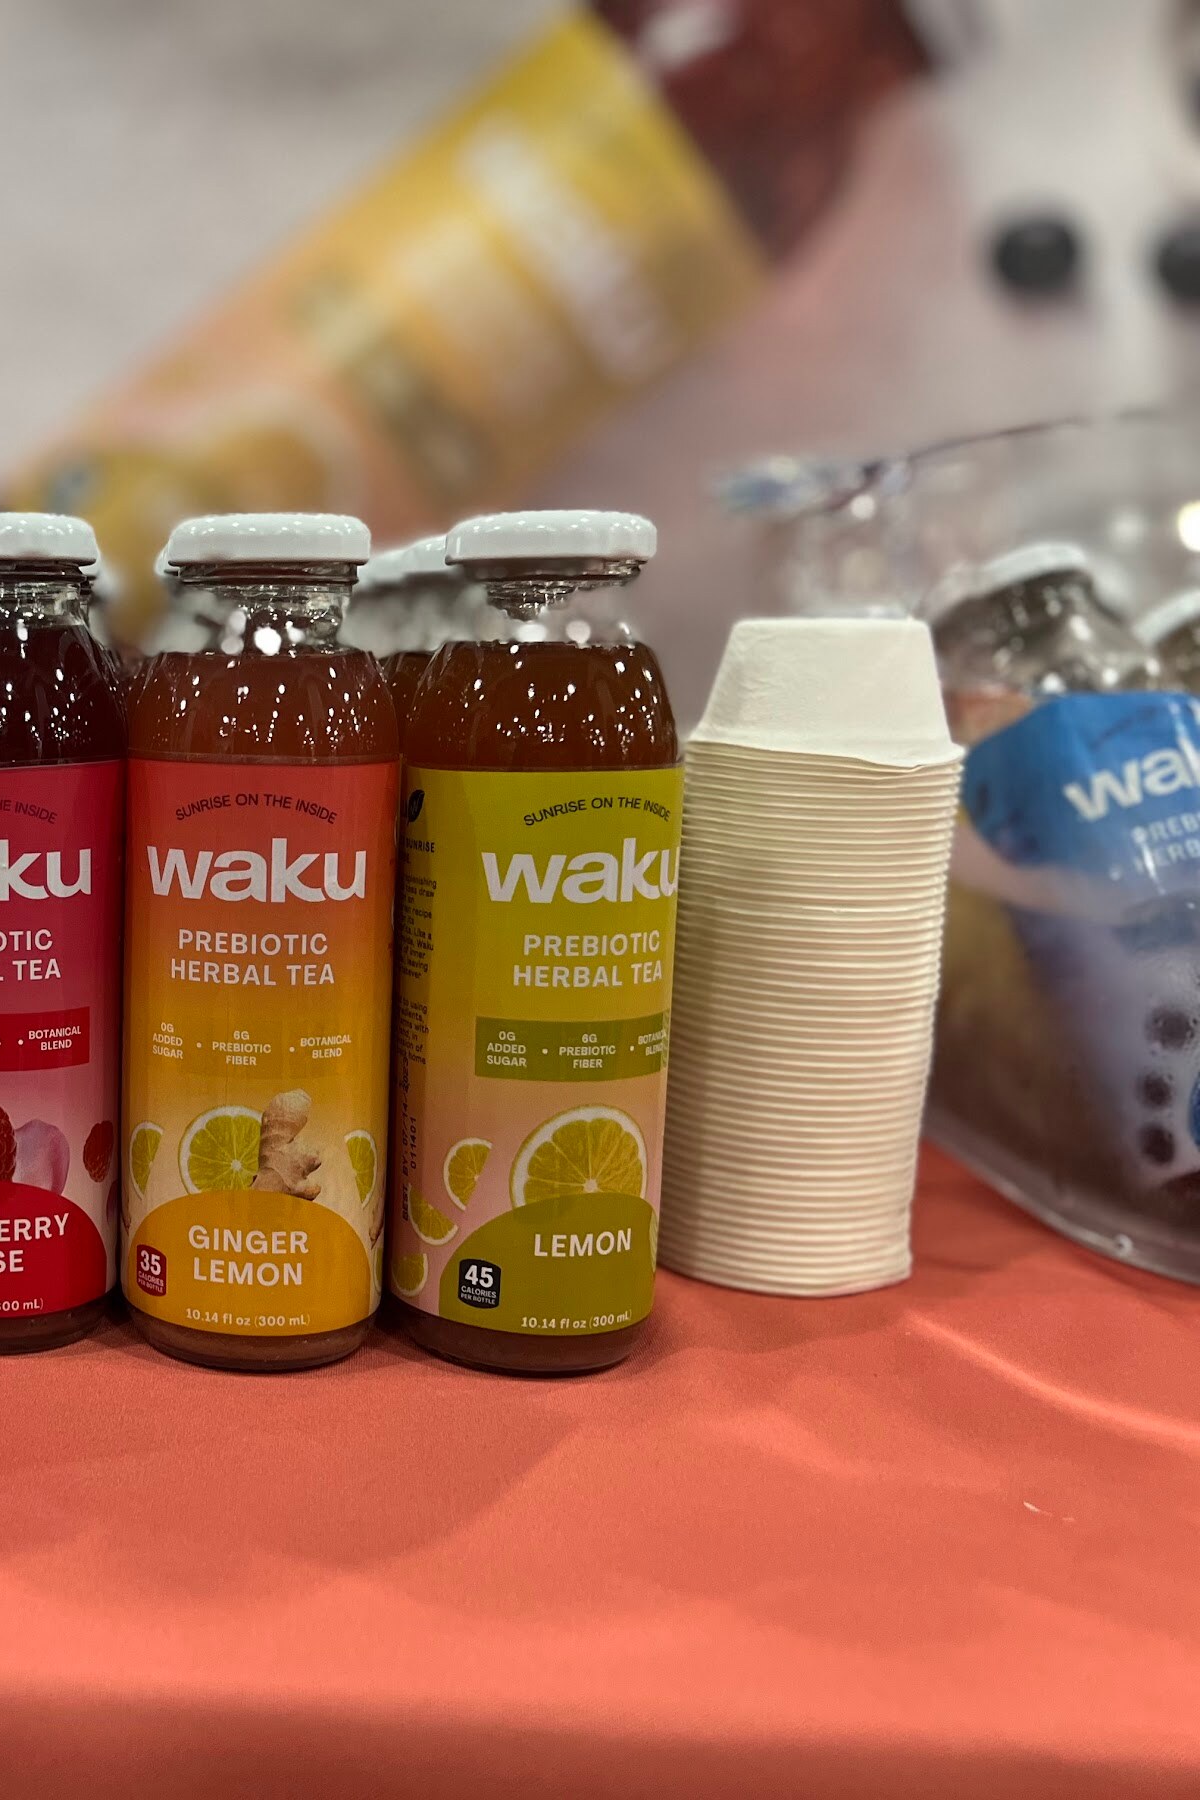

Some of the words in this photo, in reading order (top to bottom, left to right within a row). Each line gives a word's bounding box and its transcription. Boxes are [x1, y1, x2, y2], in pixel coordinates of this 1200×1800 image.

[15, 801, 57, 824] INSIDE
[176, 794, 231, 821] SUNRISE
[235, 794, 259, 806] ON
[264, 794, 292, 809] THE
[296, 799, 337, 824] INSIDE
[523, 800, 586, 826] SUNRISE
[591, 798, 613, 809] ON
[618, 797, 641, 809] THE
[644, 800, 670, 822] INSIDE
[147, 838, 366, 903] waku
[482, 838, 680, 904] waku
[179, 929, 328, 955] PREBIOTIC
[524, 930, 660, 956] PREBIOTIC
[13, 959, 61, 981] TEA
[171, 959, 276, 986] HERBAL
[286, 964, 334, 985] TEA
[513, 965, 622, 988] HERBAL
[631, 960, 662, 984] TEA
[29, 1026, 81, 1039] BOTANICAL
[161, 1022, 174, 1033] 0G
[153, 1033, 183, 1046] ADDED
[234, 1031, 249, 1040] 6G
[300, 1034, 352, 1047] BOTANICAL
[499, 1031, 516, 1041] 0G
[582, 1034, 597, 1044] 6G
[40, 1039, 72, 1051] BLEND
[152, 1045, 183, 1059] SUGAR
[212, 1042, 271, 1053] PREBIOTIC
[486, 1043, 526, 1054] ADDED
[559, 1046, 616, 1056] PREBIOTIC
[312, 1048, 342, 1059] BLEND
[226, 1056, 257, 1066] FIBER
[486, 1056, 527, 1067] SUGAR
[573, 1059, 602, 1068] FIBER
[188, 1225, 309, 1254] GINGER
[534, 1228, 632, 1258] LEMON
[140, 1250, 161, 1275] 35
[193, 1257, 303, 1286] LEMON
[465, 1264, 493, 1288] 45
[461, 1285, 496, 1299] CALORIES
[472, 1294, 496, 1305] BOTTLE
[186, 1308, 218, 1323] 10.14
[223, 1314, 232, 1324] fl
[236, 1317, 250, 1326] oz
[521, 1316, 556, 1328] 10.14
[560, 1319, 570, 1328] fl
[573, 1319, 586, 1329] oz
